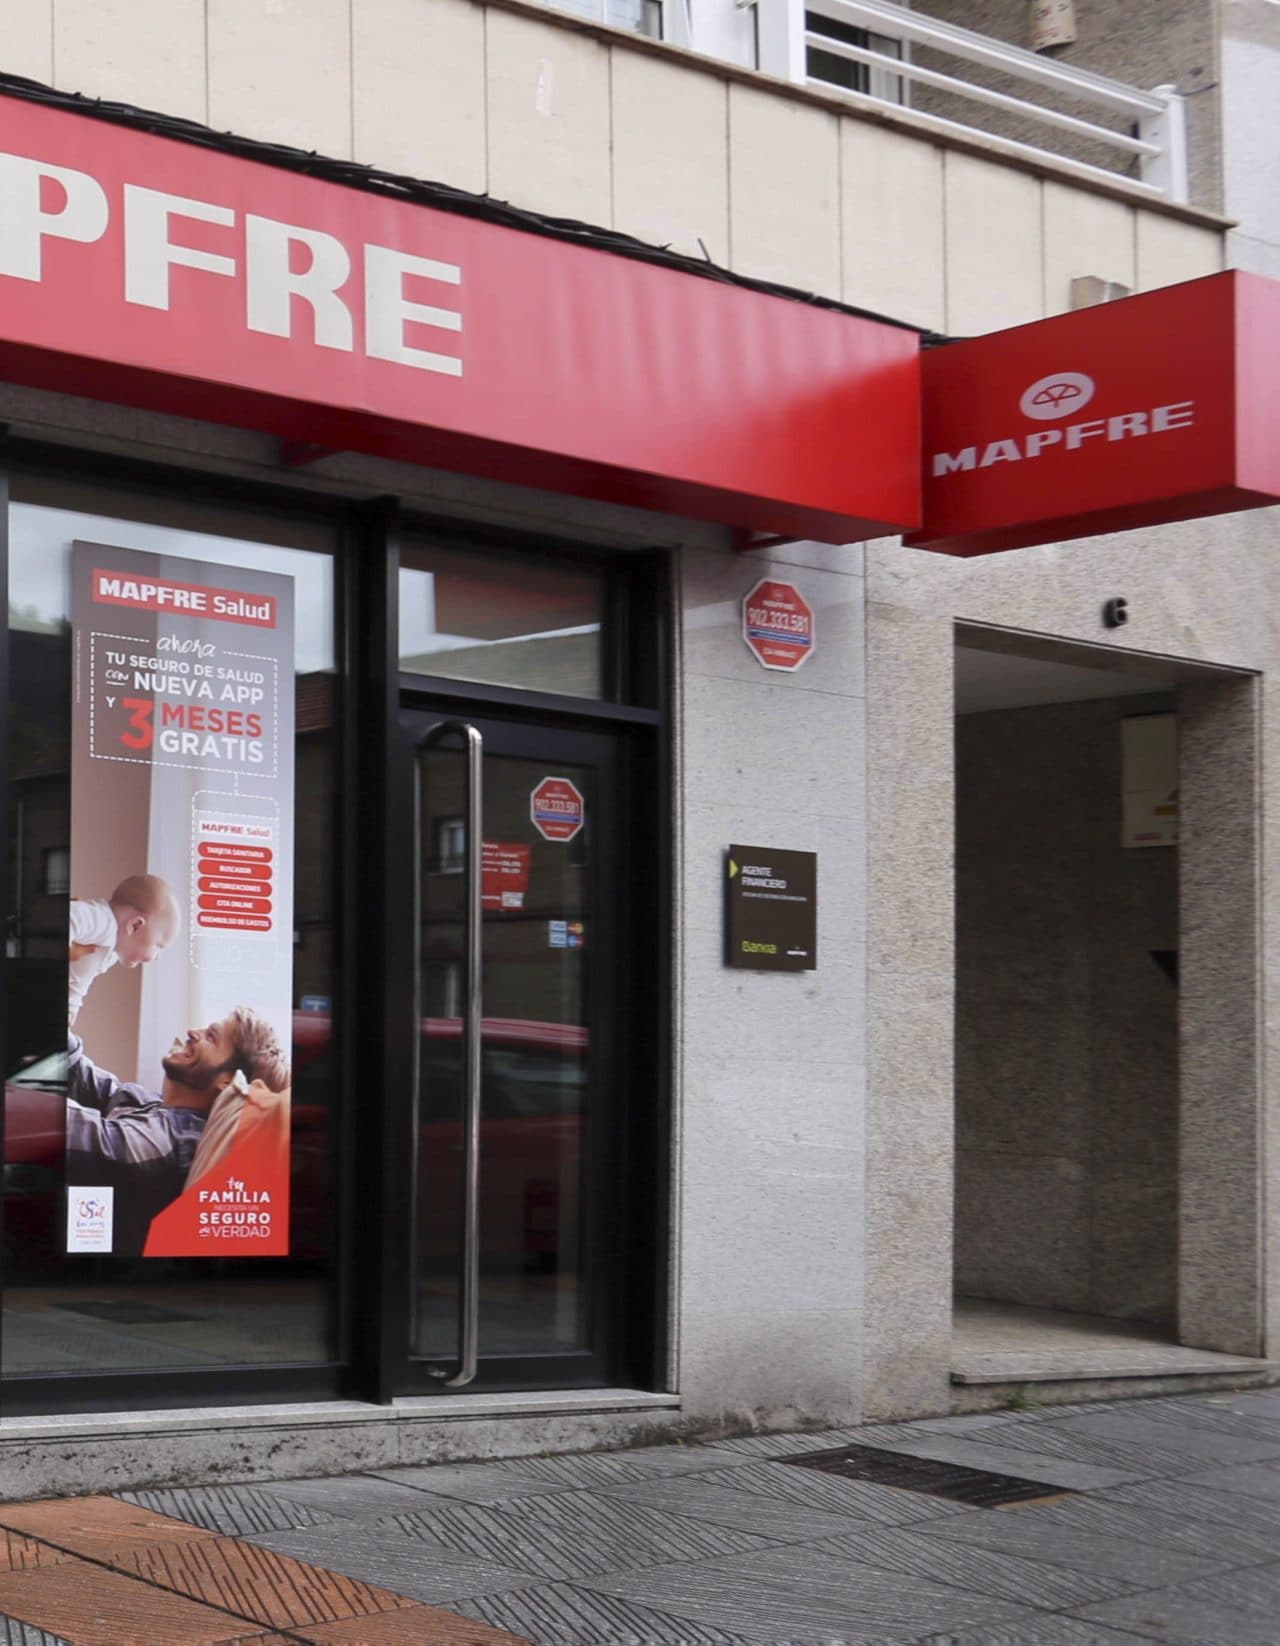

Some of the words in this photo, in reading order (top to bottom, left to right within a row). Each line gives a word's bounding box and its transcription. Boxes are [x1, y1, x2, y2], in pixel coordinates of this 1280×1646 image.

[933, 401, 1194, 477] MAPFRE
[99, 577, 207, 611] MAPFRE
[213, 596, 270, 620] Salud
[156, 633, 216, 659] ahora
[105, 651, 126, 665] TU
[129, 654, 190, 674] SEGURO
[194, 664, 213, 678] DE
[217, 667, 264, 684] SALUD
[134, 671, 213, 699] NUEVA
[219, 683, 264, 705] APP
[106, 696, 116, 708] Y
[120, 697, 155, 749] 3
[161, 702, 262, 738] MESES
[159, 730, 263, 763] GRATIS
[199, 1191, 271, 1203] FAMILIA
[199, 1212, 271, 1225] SEGURO
[211, 1225, 271, 1238] VERDAD
